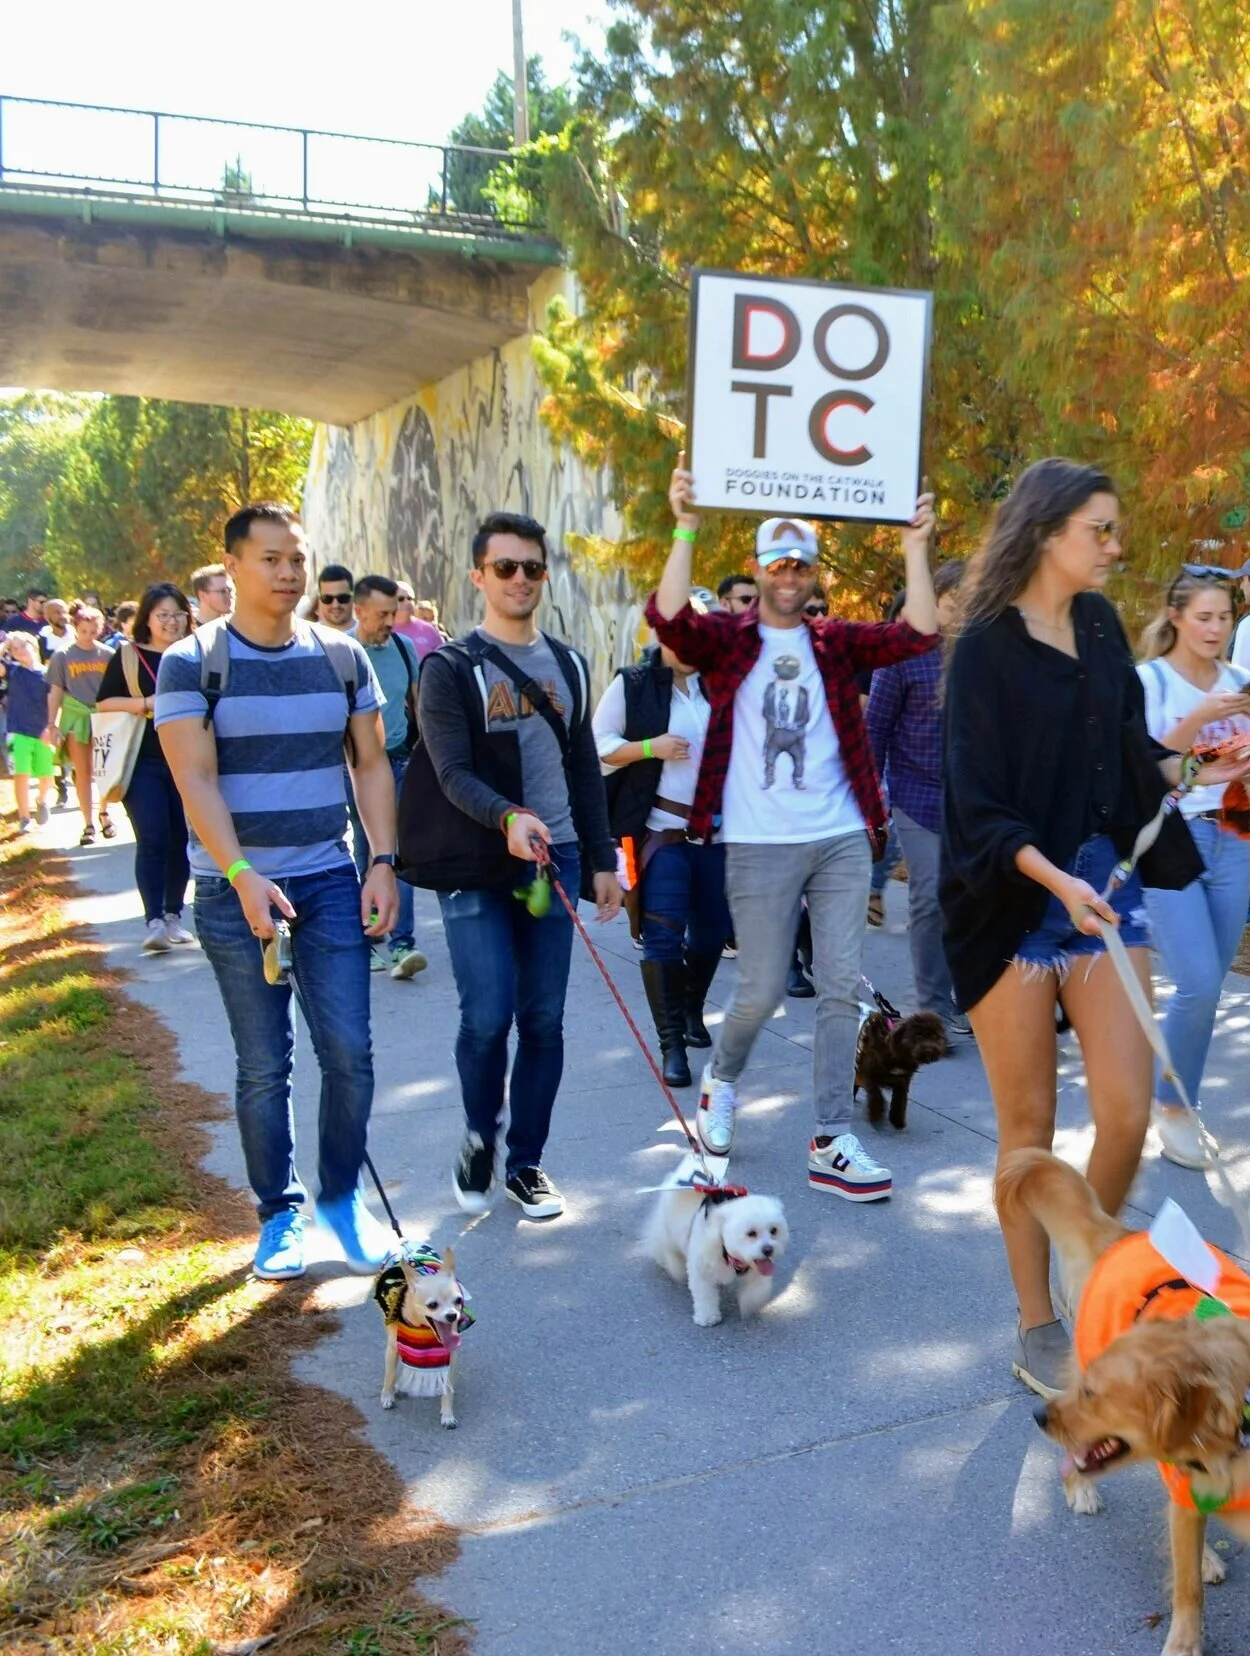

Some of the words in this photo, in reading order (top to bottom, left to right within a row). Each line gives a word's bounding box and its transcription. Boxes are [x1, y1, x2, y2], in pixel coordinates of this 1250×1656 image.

[731, 292, 891, 381] DO
[730, 380, 876, 466] TC
[725, 480, 886, 505] FOUNDATION
[726, 467, 778, 481] DOGGIES
[781, 472, 800, 481] ON
[803, 474, 824, 484] THE
[828, 475, 885, 488] CATWALK
